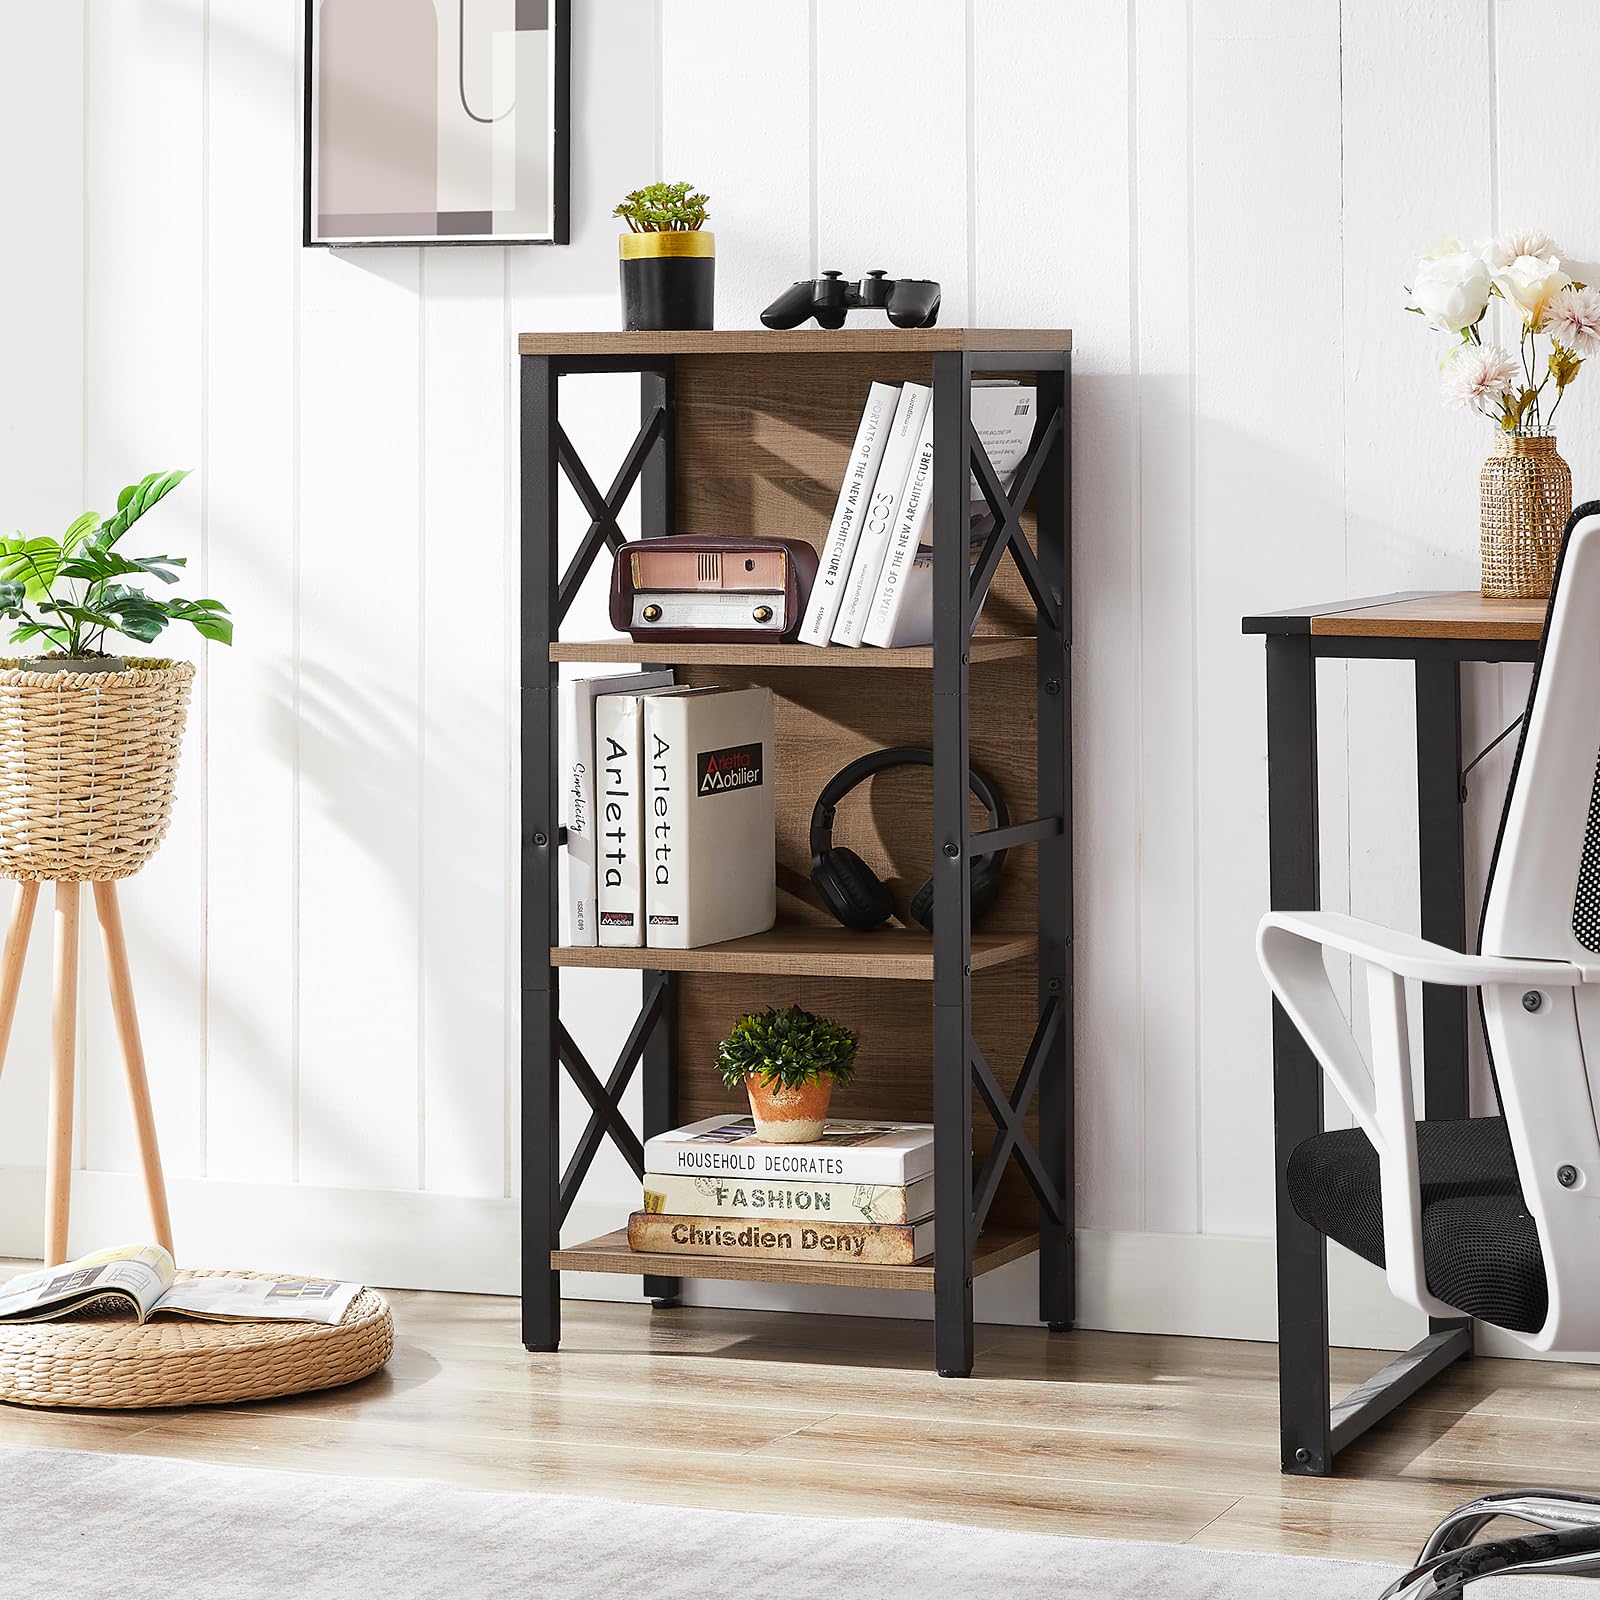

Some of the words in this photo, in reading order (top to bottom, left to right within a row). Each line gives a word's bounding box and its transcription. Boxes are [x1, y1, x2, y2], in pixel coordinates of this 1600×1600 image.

[861, 445, 871, 459] OF
[855, 461, 867, 479] THE
[849, 481, 861, 505] NEW
[905, 451, 932, 522] ARCHITECTURE
[869, 492, 894, 534] COS
[828, 507, 854, 576] ARCHITECTURE
[898, 523, 912, 547] NEW
[892, 550, 905, 568] THE
[888, 570, 899, 585] OF
[700, 767, 759, 791] Mobilier
[570, 763, 586, 835] Simplicity
[653, 734, 671, 884] Arletta
[606, 737, 629, 887] Arletta
[678, 1152, 755, 1170] HOUSEHOLD
[765, 1156, 842, 1174] DECORATES
[715, 1187, 831, 1210] FASHION
[671, 1224, 791, 1248] Chrisdien
[802, 1228, 866, 1256] Deny
